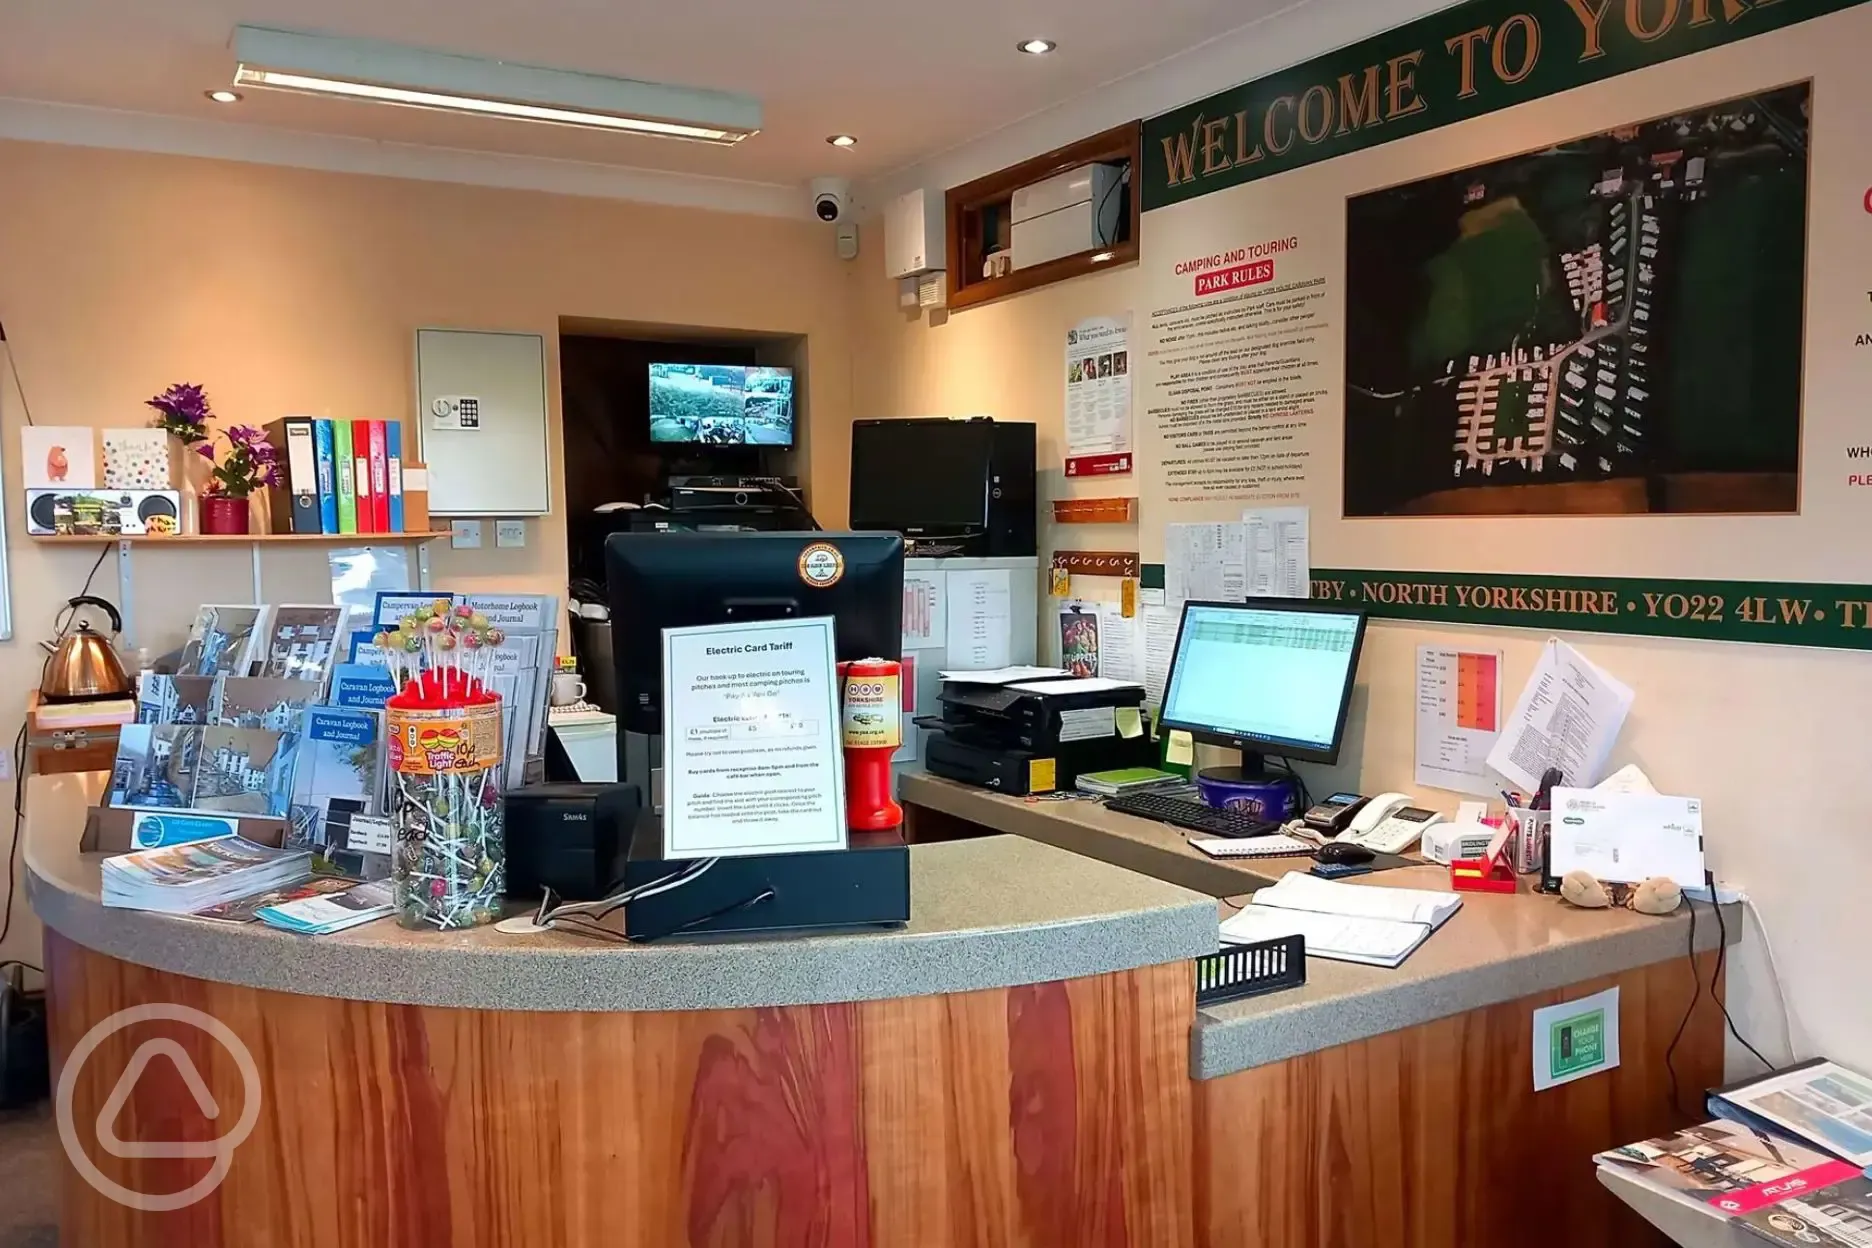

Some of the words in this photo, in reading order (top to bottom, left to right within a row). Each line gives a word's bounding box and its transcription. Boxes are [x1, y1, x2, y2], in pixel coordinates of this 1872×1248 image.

[1160, 50, 1427, 188] WELCOME
[1444, 14, 1543, 98] TO
[1175, 254, 1221, 276] CAMPING
[1223, 249, 1245, 265] AND
[1248, 236, 1298, 260] TOURING
[1198, 274, 1229, 292] PARK
[1232, 263, 1271, 284] RULES
[471, 601, 510, 612] Motorhome
[510, 601, 539, 613] Logbook
[1361, 581, 1448, 607] NORTH
[1454, 584, 1620, 616] YORKSHIRE
[1641, 592, 1726, 622] YO22
[1734, 596, 1813, 625] 4LW
[497, 614, 524, 624] Journal
[706, 645, 743, 656] Electric
[744, 643, 768, 654] Card
[769, 641, 793, 652] Tariff
[340, 681, 368, 691] Caravan
[348, 695, 361, 704] and
[361, 695, 386, 705] Journal
[316, 718, 342, 730] Caravan
[341, 721, 369, 732] Logbook
[713, 715, 741, 724] Electric
[323, 729, 336, 738] and
[335, 731, 361, 741] Journal
[427, 751, 455, 761] Traffic
[456, 743, 476, 759] 10p
[430, 759, 453, 769] Light
